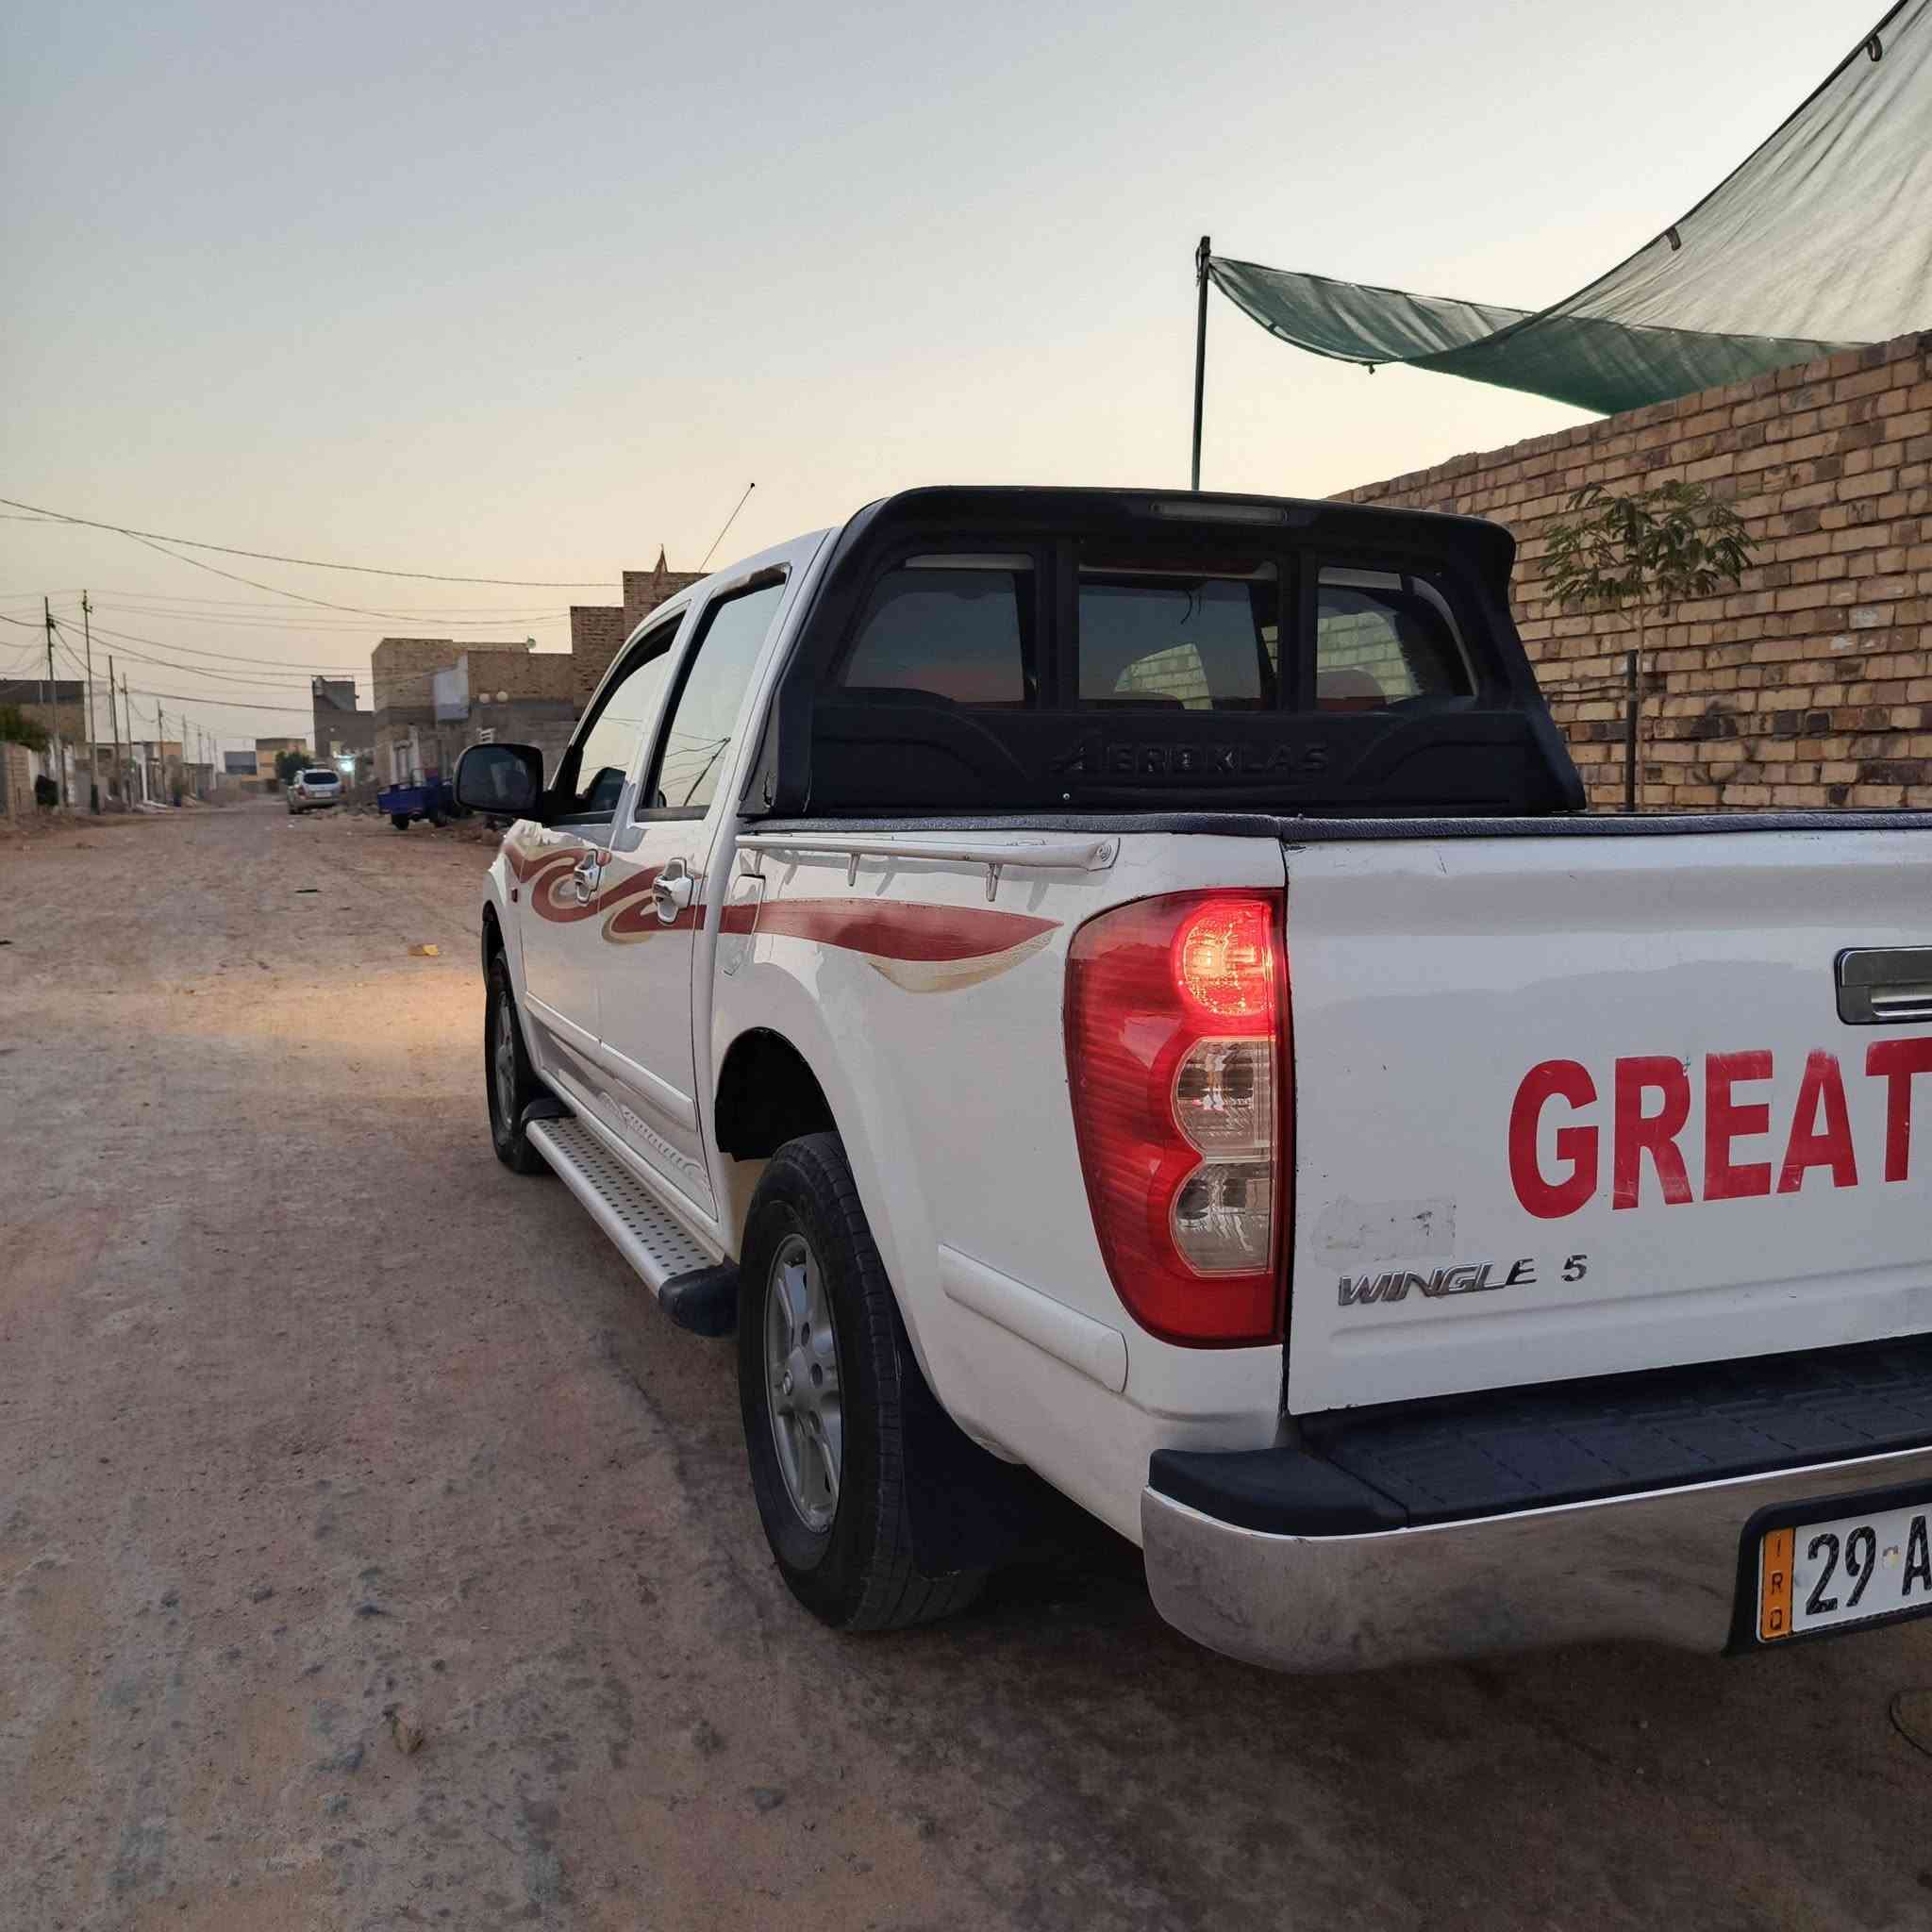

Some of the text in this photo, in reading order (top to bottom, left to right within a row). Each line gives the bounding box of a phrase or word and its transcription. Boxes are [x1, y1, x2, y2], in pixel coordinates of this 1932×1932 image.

[1509, 1037, 1932, 1219] GREAT
[1338, 1254, 1587, 1307] WINGLE 5
[1806, 1525, 1876, 1616] 29
